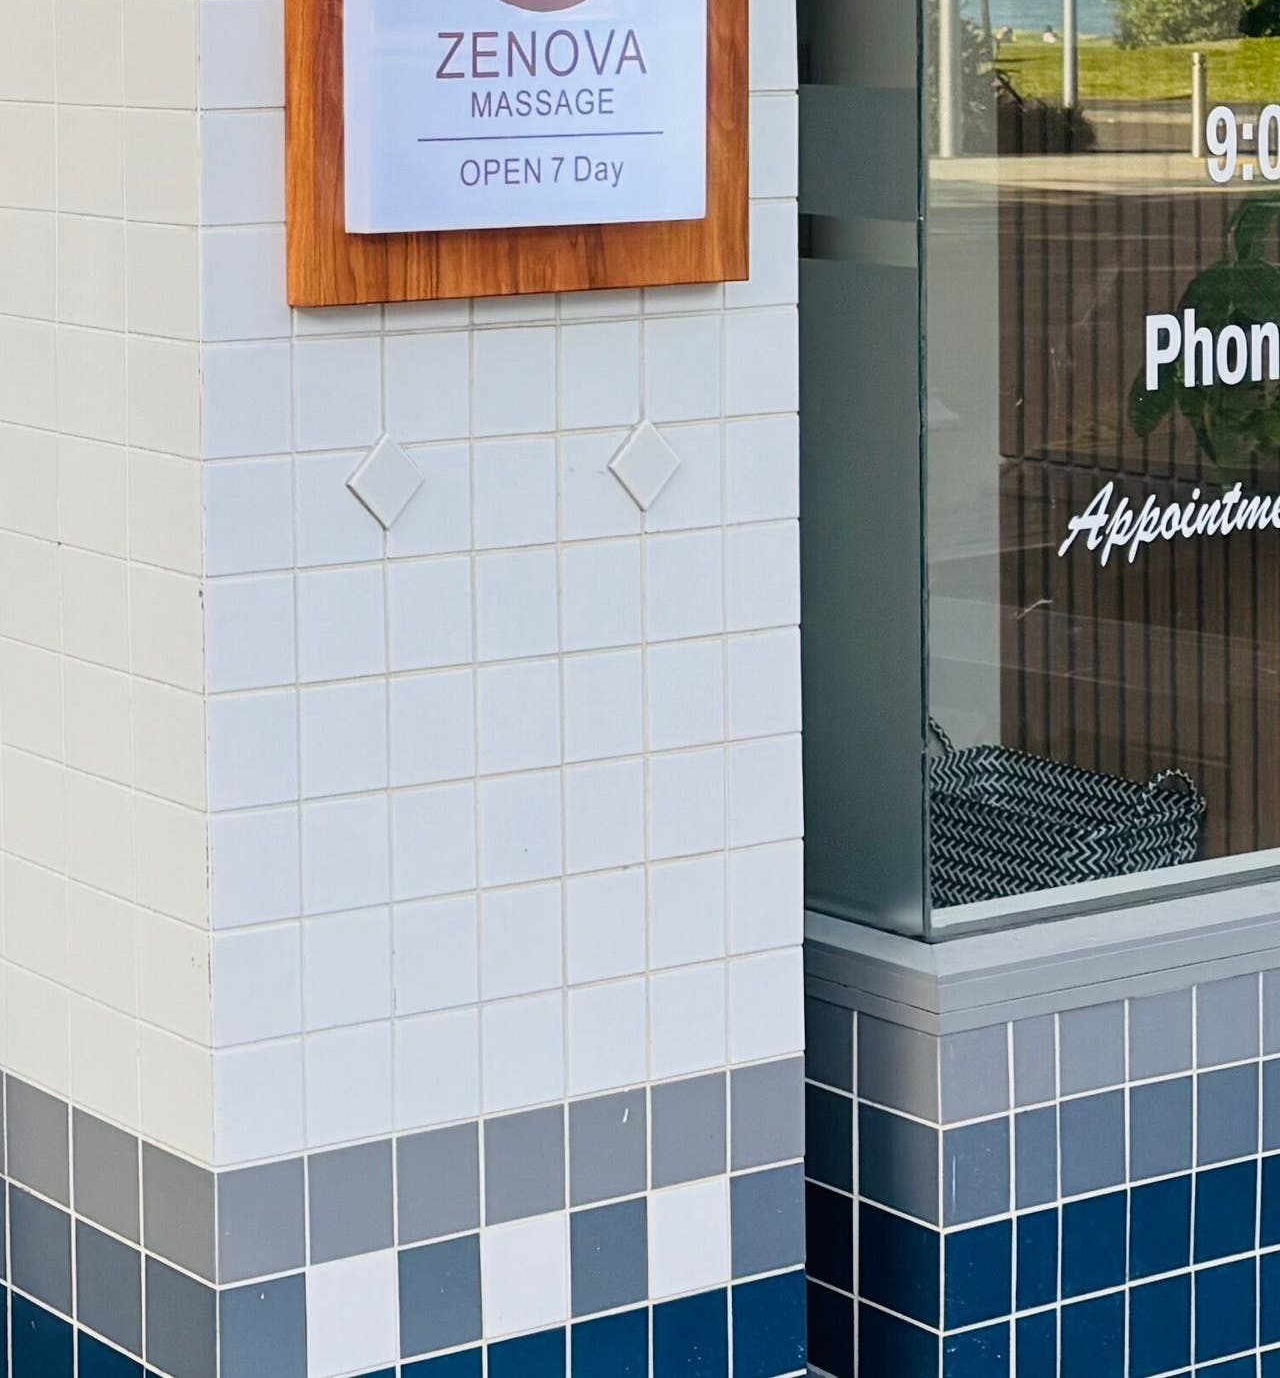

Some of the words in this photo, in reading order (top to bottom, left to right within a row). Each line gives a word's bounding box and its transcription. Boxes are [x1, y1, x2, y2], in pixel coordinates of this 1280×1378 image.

[435, 28, 648, 81] ZENOVA
[469, 86, 615, 120] MASSAGE
[459, 156, 542, 189] OPEN
[549, 155, 566, 186] 7
[572, 154, 624, 190] Day
[1145, 307, 1280, 392] Phon
